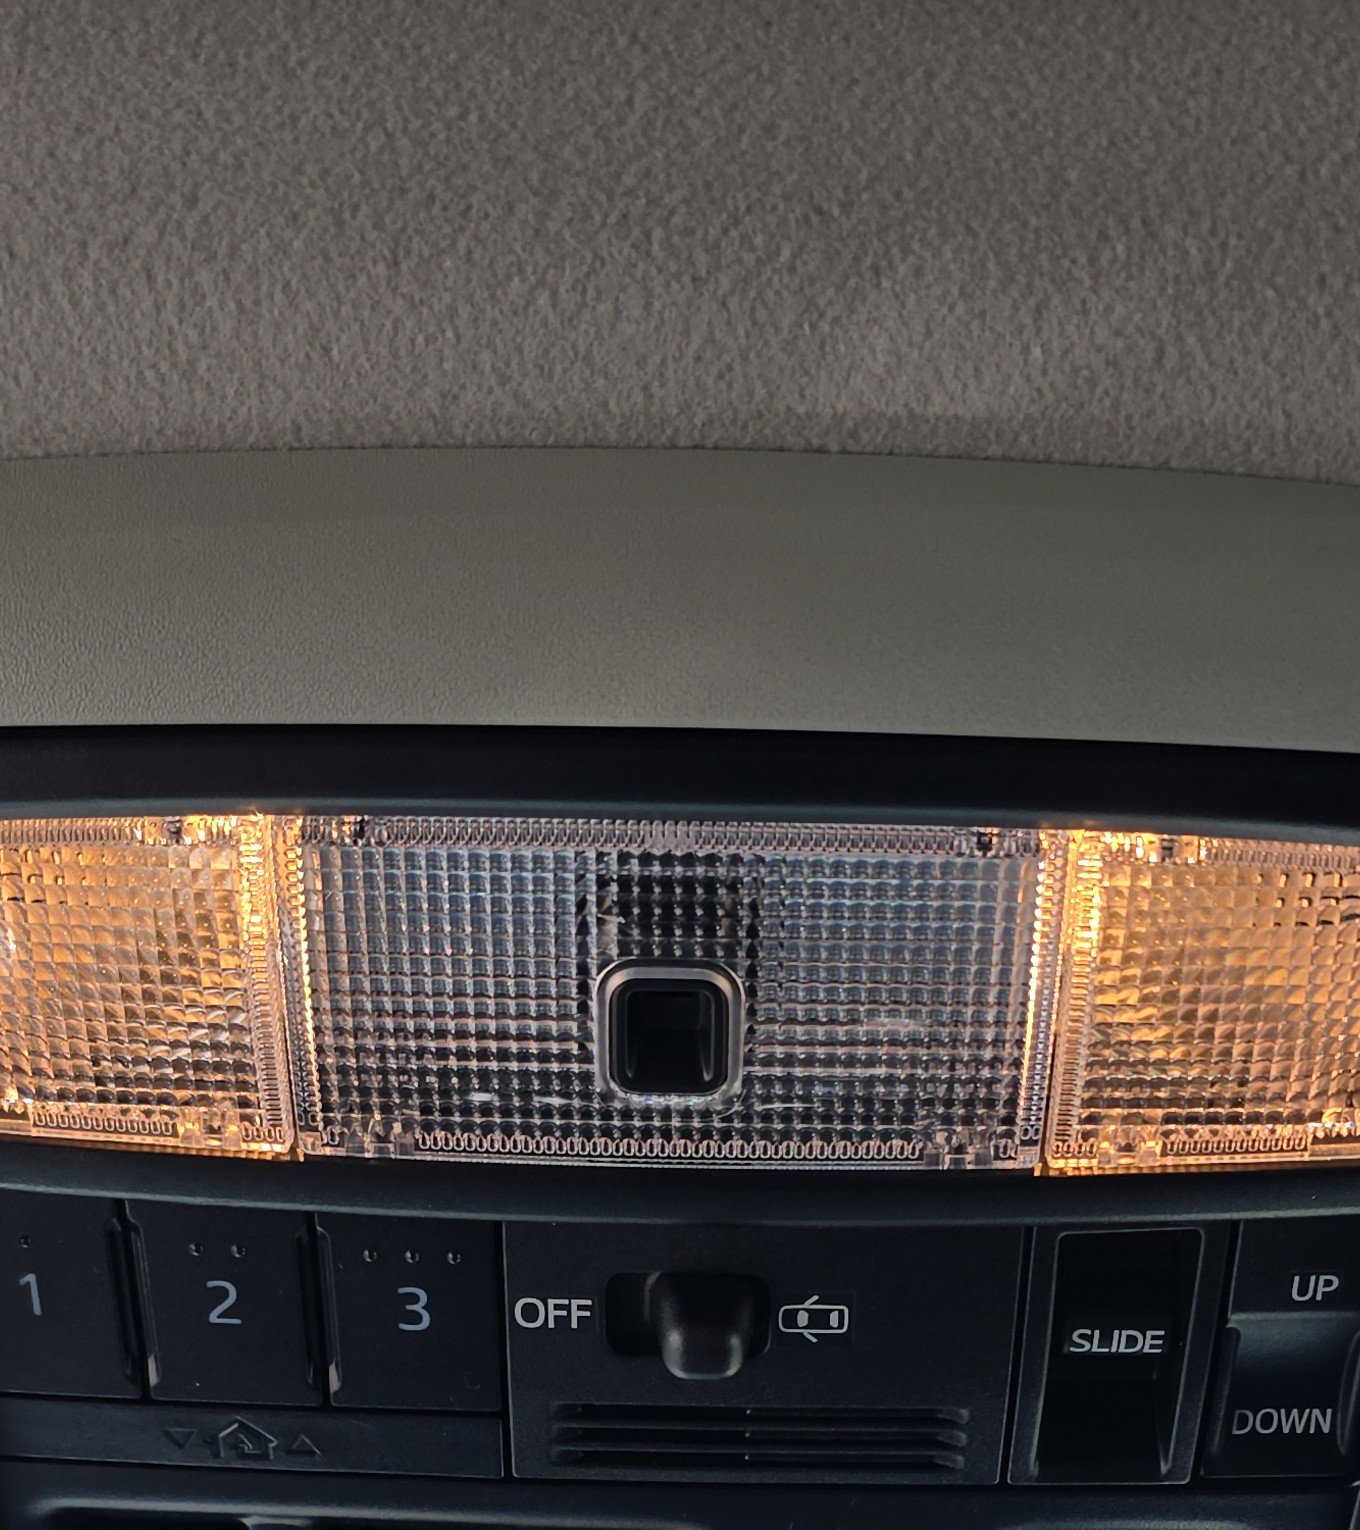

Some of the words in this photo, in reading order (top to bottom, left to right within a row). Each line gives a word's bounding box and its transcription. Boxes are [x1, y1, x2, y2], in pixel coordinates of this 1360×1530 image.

[19, 1273, 41, 1315] 1
[207, 1281, 241, 1324] 2
[1292, 1275, 1339, 1301] UP
[398, 1287, 430, 1330] 3
[515, 1298, 592, 1328] OFF
[1070, 1329, 1165, 1353] SLIDE
[1232, 1409, 1332, 1434] DOWN
